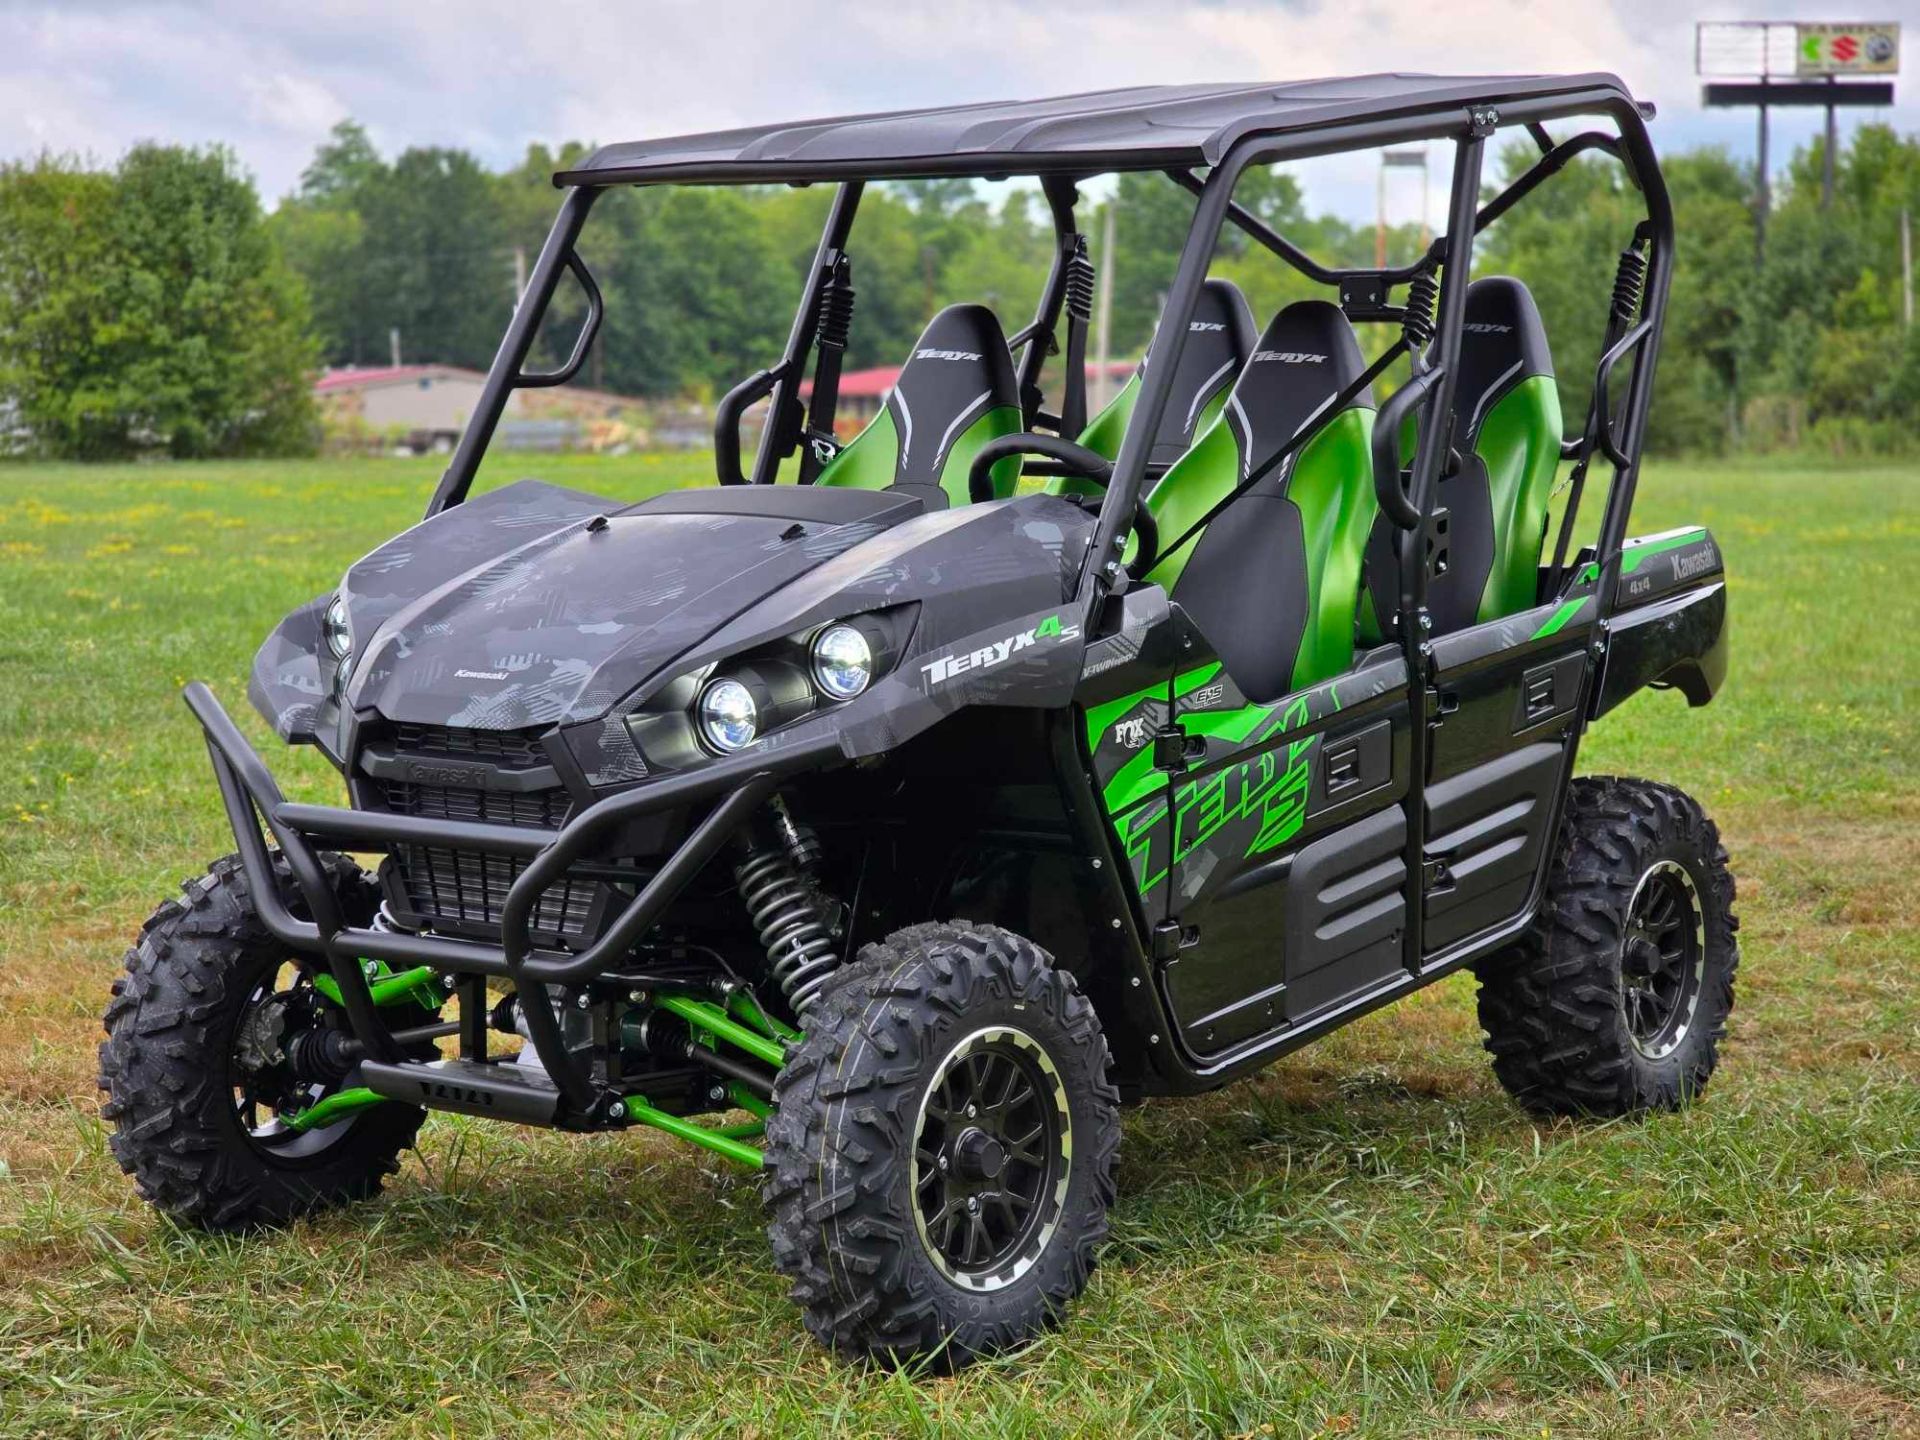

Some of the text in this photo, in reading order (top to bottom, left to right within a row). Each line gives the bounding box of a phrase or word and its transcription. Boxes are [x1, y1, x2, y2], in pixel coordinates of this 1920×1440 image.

[916, 348, 983, 361] TERYX
[1254, 350, 1329, 364] TERYX
[1670, 542, 1717, 581] Kawasaki
[1630, 577, 1651, 595] 4x4
[454, 669, 510, 681] Kawasaki
[1115, 717, 1144, 749] FOX
